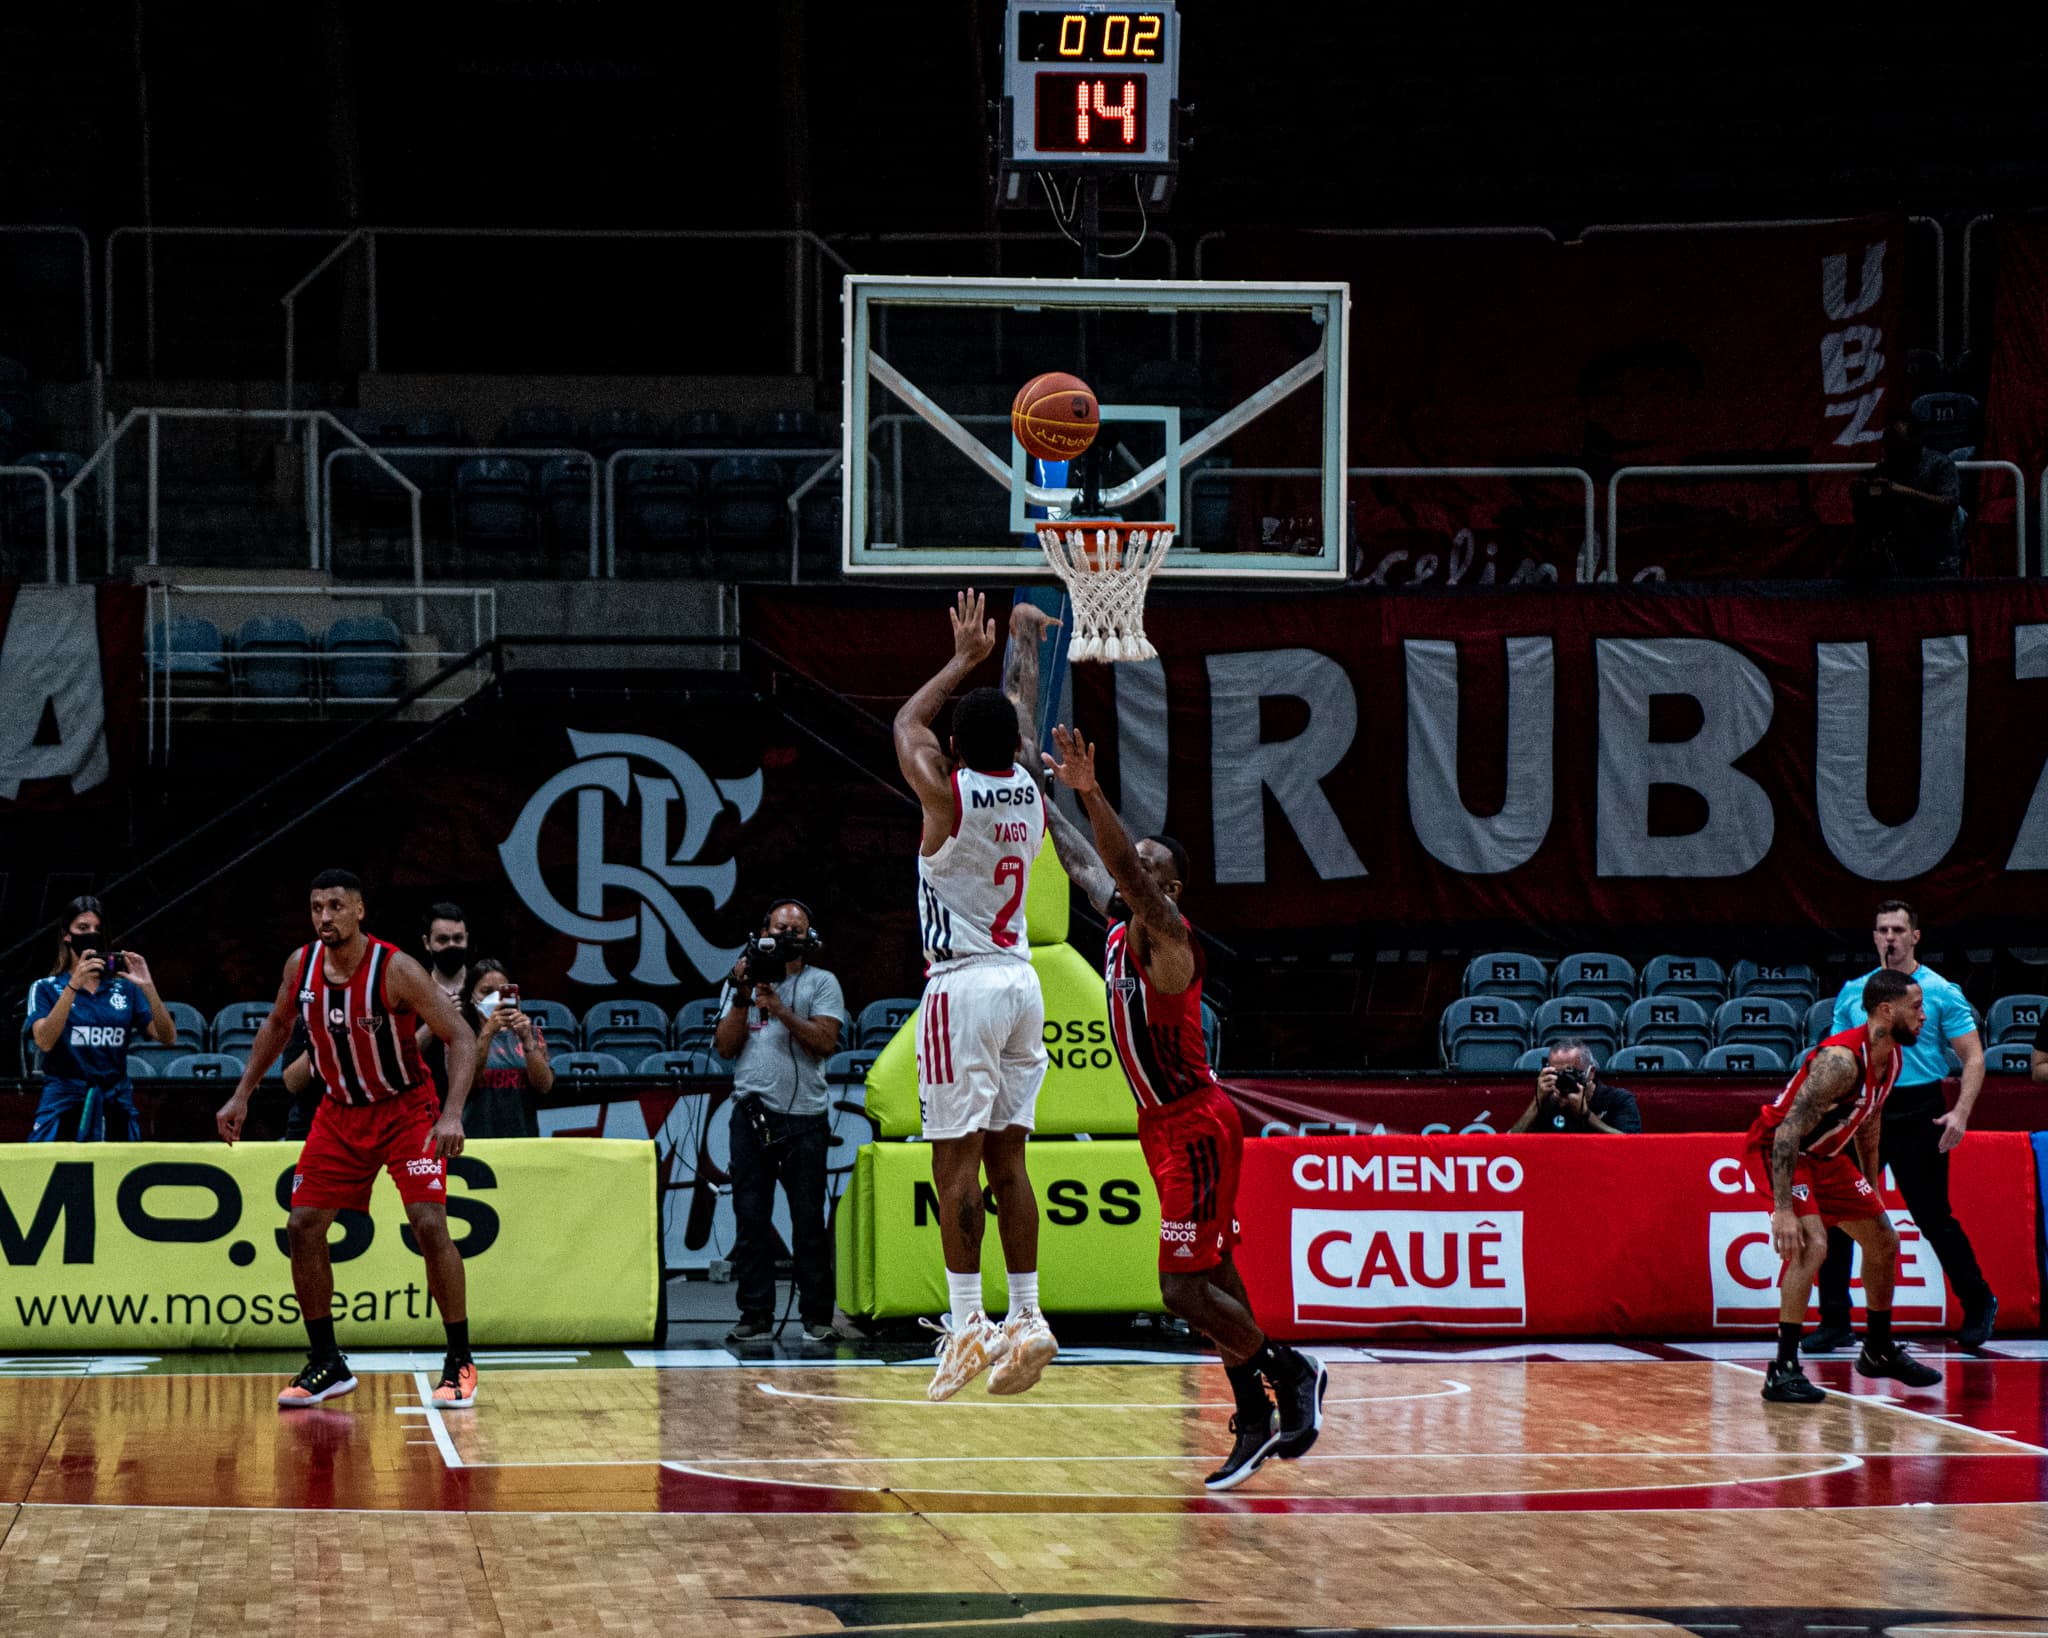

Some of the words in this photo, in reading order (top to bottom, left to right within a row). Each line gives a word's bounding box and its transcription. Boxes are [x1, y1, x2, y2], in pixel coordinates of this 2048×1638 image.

[1077, 80, 1136, 144] 14
[995, 822, 1027, 842] YAGO
[990, 855, 1024, 948] 2
[91, 1026, 126, 1047] BRB
[1291, 1153, 1525, 1193] CIMENTO
[1307, 1220, 1506, 1288] CAUÊ
